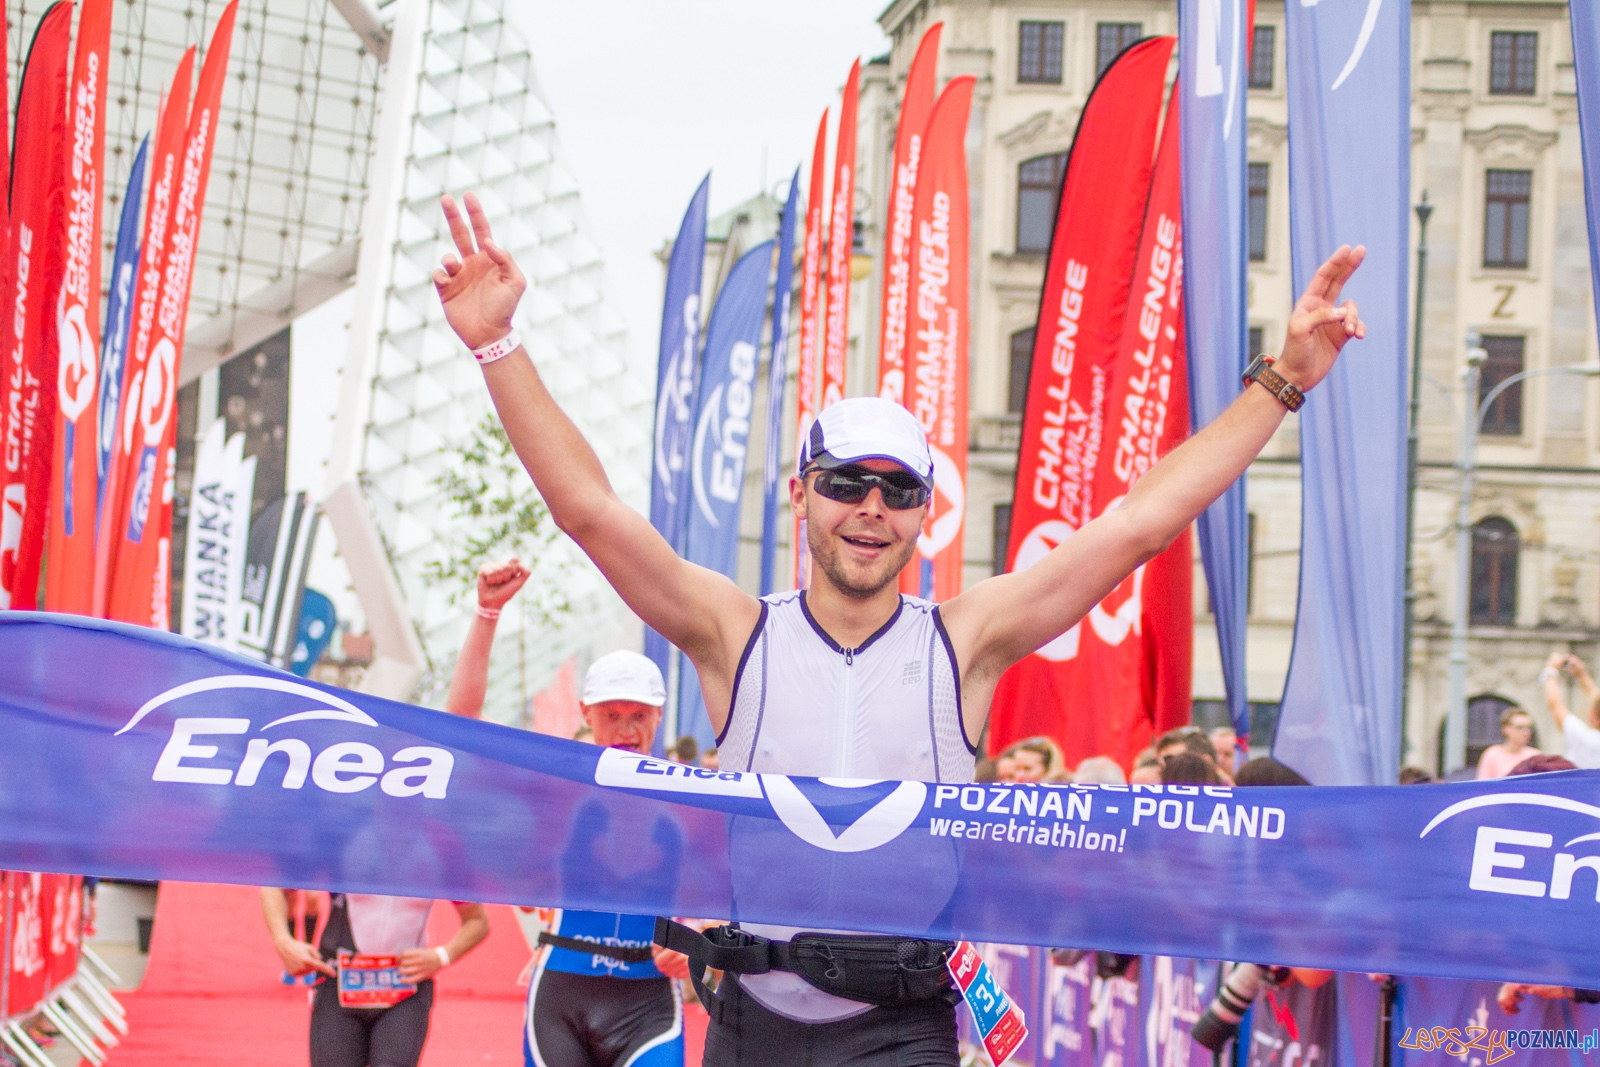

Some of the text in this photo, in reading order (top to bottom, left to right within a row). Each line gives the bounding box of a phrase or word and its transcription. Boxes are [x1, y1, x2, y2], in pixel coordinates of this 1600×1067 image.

[65, 79, 88, 296] CHALLENGE
[5, 221, 33, 473] CHALLENGE
[1113, 213, 1177, 483] CHALLENGE
[1491, 285, 1517, 319] Z
[709, 339, 758, 503] Enea
[1033, 258, 1088, 510] CHALLENGE
[1060, 398, 1088, 525] FAMILY
[151, 717, 455, 800] Enea
[635, 758, 742, 783] Enea
[933, 785, 1093, 822] POZNAŃ
[1131, 796, 1286, 840] POLAND
[929, 817, 1127, 853] wearetriathlon!
